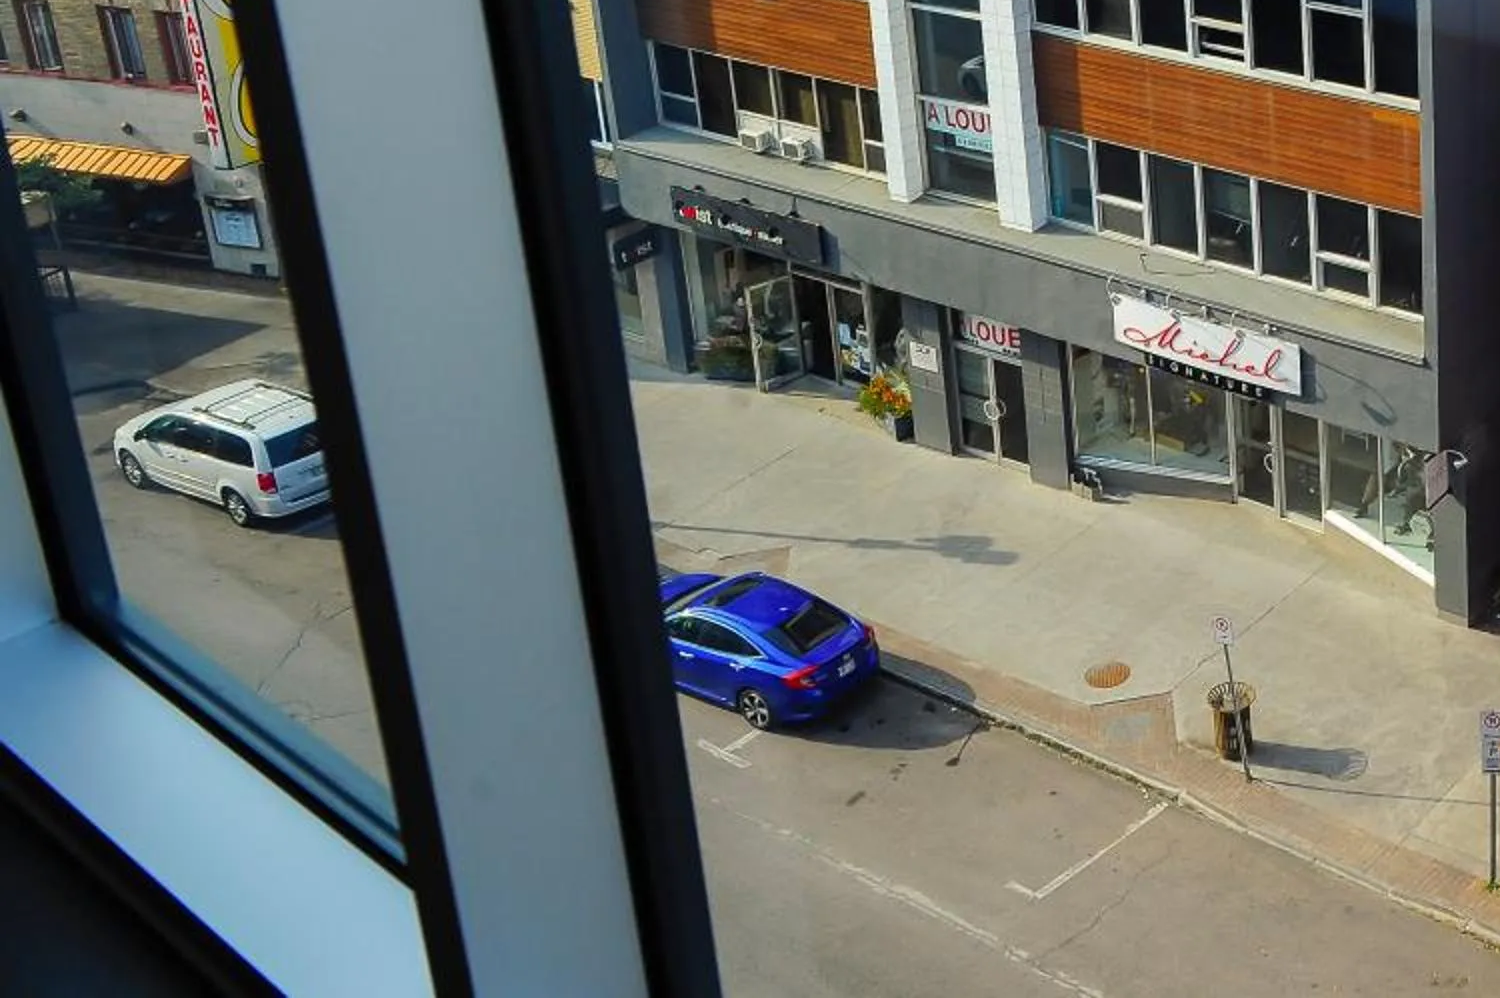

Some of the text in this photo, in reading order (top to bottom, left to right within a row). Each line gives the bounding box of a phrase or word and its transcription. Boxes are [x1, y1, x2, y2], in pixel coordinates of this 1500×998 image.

[927, 101, 941, 125] A
[970, 318, 1021, 348] LOUE
[1123, 320, 1289, 382] Michel
[1148, 353, 1264, 397] SIGNATURE
